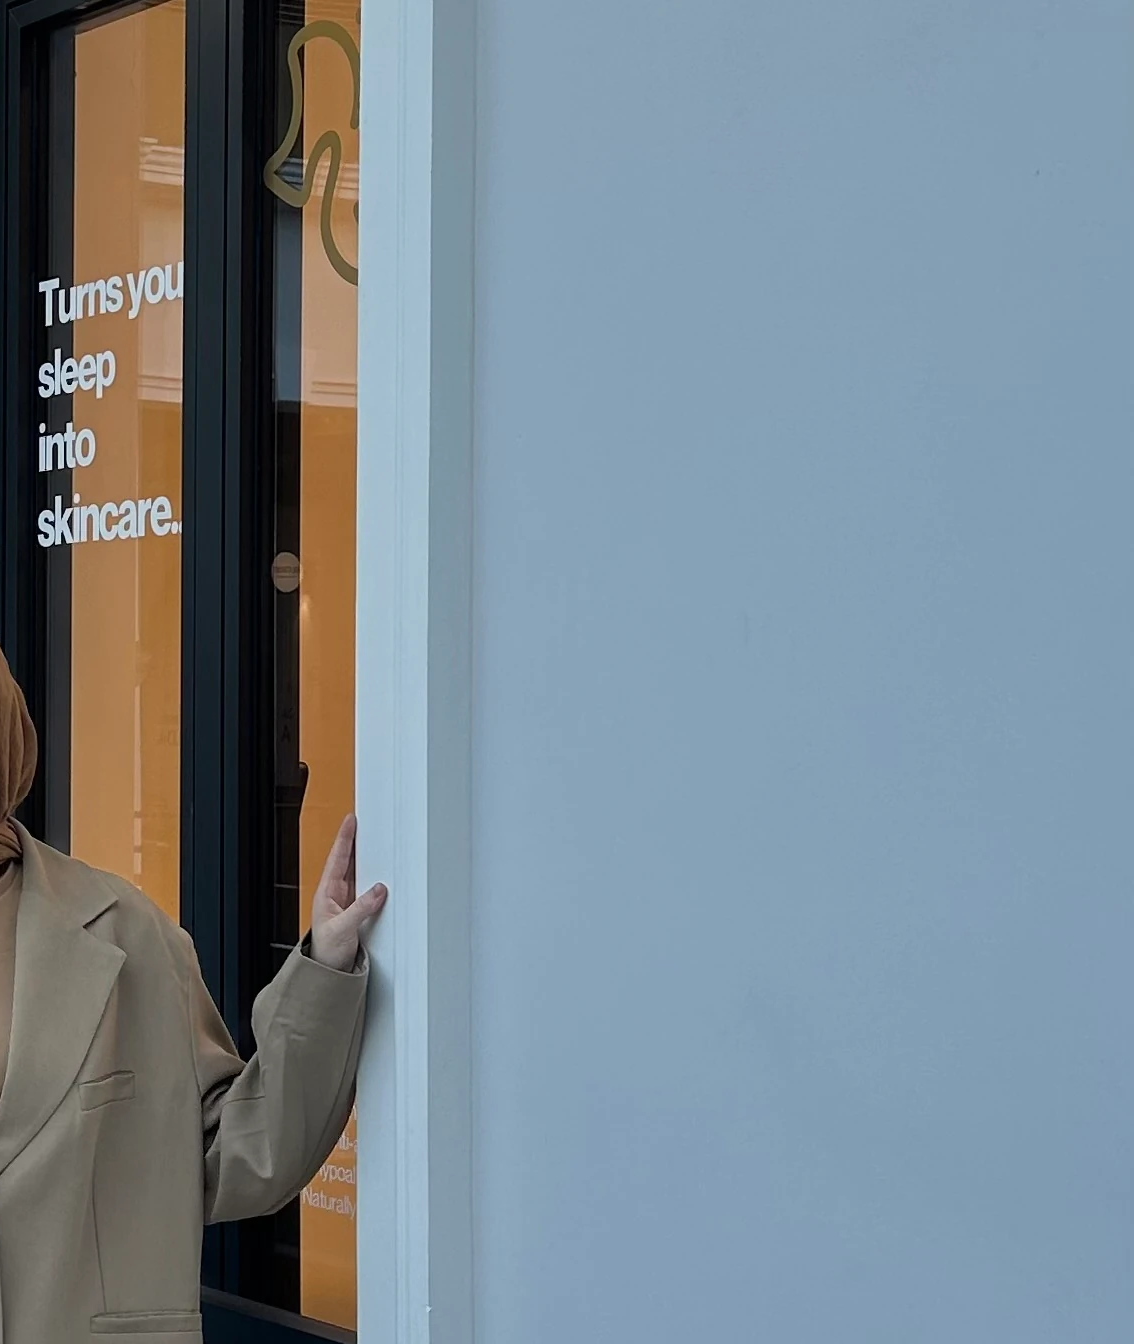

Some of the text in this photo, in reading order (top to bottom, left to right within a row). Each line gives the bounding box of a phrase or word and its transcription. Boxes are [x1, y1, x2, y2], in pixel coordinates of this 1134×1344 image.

[38, 275, 124, 327] Turns
[38, 348, 116, 399] sleep
[38, 421, 96, 472] into
